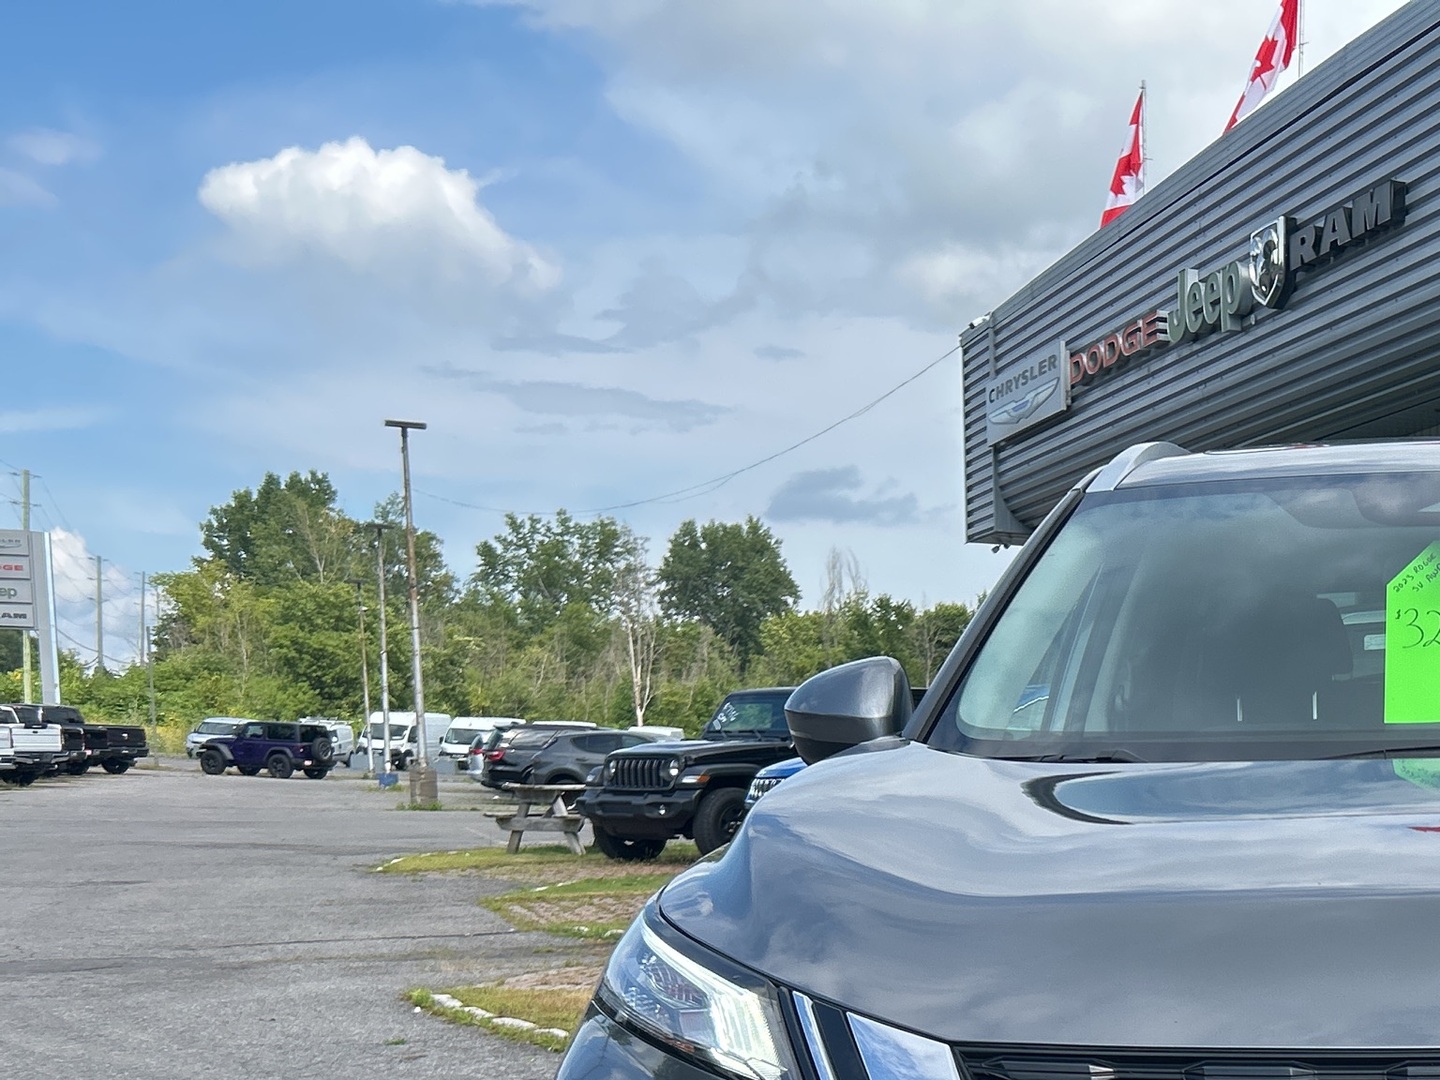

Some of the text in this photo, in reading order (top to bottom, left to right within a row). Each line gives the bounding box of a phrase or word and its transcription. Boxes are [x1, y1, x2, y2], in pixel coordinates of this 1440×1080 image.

[1289, 180, 1393, 271] RAM
[1167, 261, 1245, 344] Jeep
[987, 353, 1059, 404] CHRYSLER
[1069, 311, 1162, 386] DODGE
